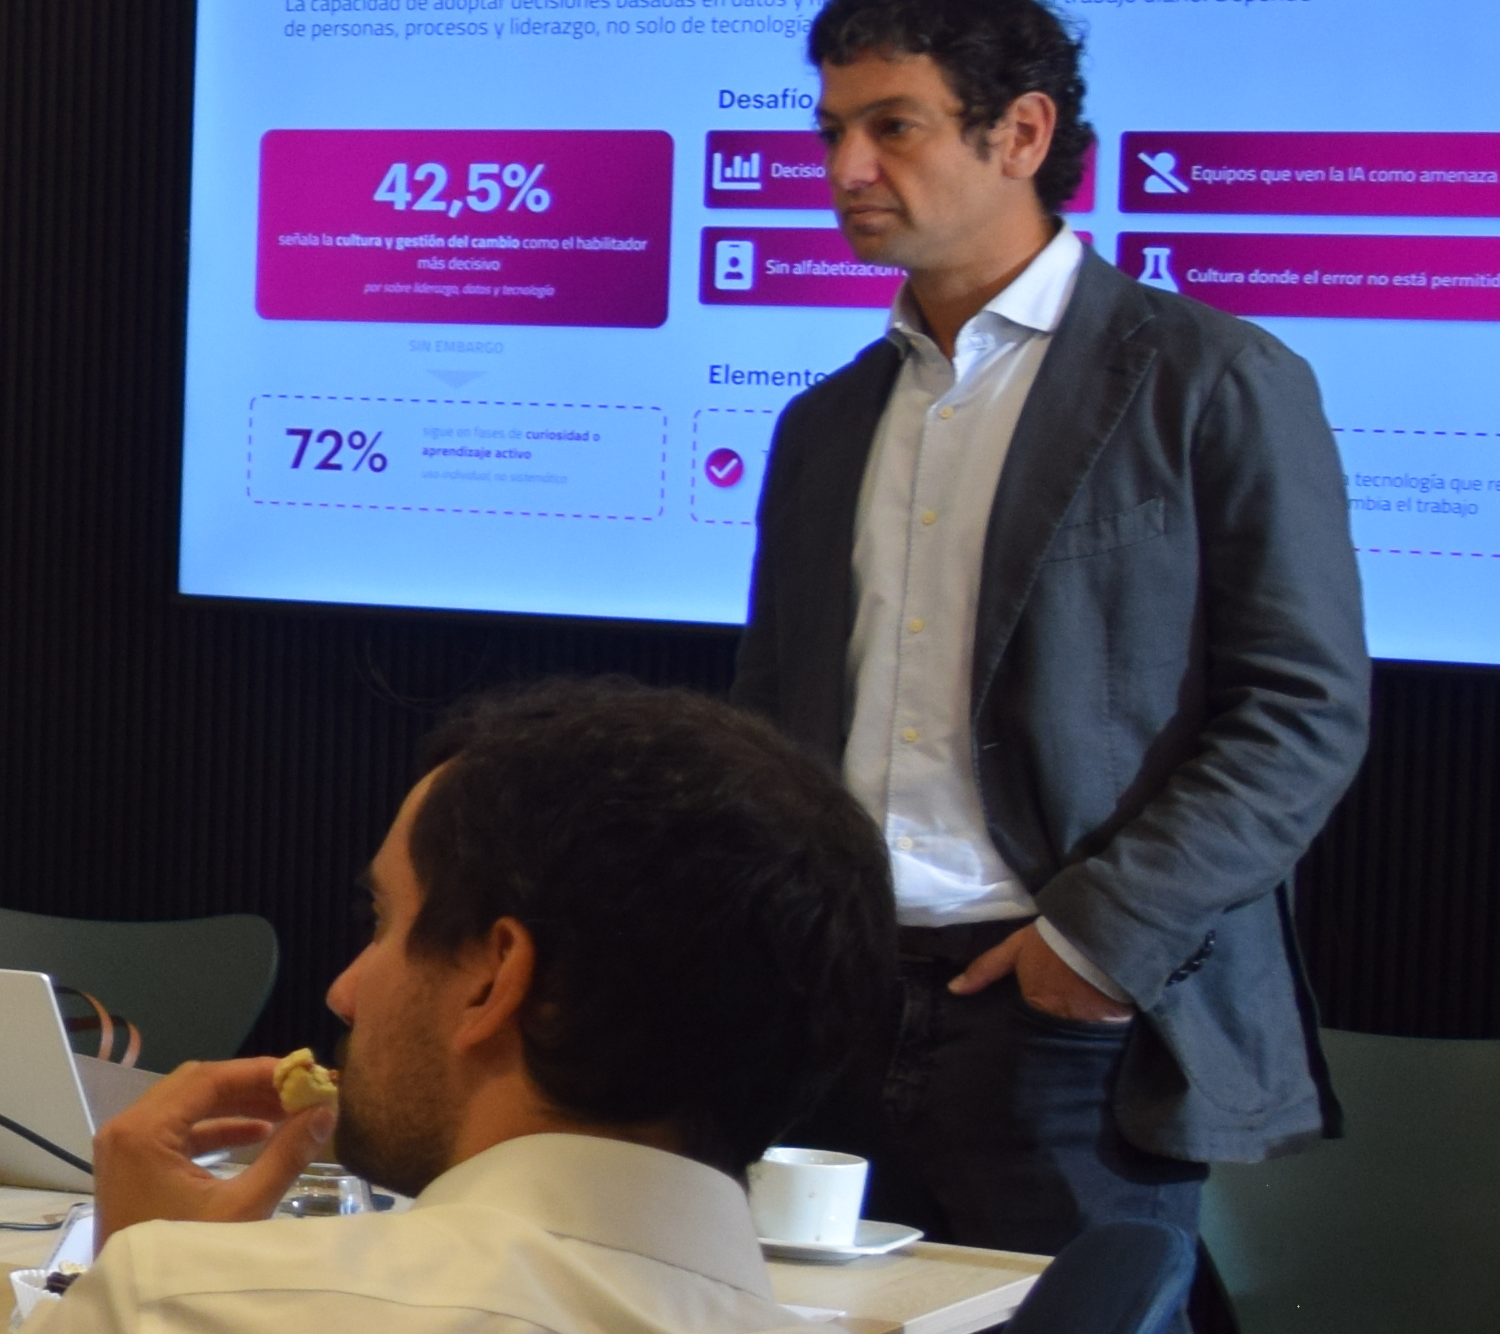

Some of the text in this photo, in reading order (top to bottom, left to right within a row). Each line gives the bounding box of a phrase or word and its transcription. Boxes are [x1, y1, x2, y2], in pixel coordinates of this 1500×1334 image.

[284, 15, 811, 40] de personas, procesos y liderazgo, no solo de tecnología
[719, 88, 813, 110] Desafío
[770, 163, 826, 178] Decisio
[1191, 166, 1498, 185] Equipos que ven la IA como amenaza
[373, 162, 551, 217] 42,5%
[278, 232, 648, 251] señala la cultura y gestión del cambio como el habilitador
[417, 256, 501, 271] más decisivo
[765, 259, 790, 275] Sin
[1186, 268, 1244, 283] Cultura
[1248, 269, 1299, 284] donde
[1303, 270, 1319, 284] el
[1322, 273, 1363, 285] error
[1367, 275, 1389, 286] no
[1392, 272, 1427, 286] está
[408, 339, 504, 355] SIN EMBARGO
[708, 363, 828, 387] Elemento
[525, 429, 590, 442] curiosidad
[593, 432, 600, 442] o
[285, 428, 388, 473] 72%
[422, 445, 532, 460] aprendizaje activo
[1355, 473, 1445, 493] tecnología
[1450, 478, 1482, 494] que
[1396, 497, 1411, 512] el
[1416, 498, 1478, 517] trabajo
